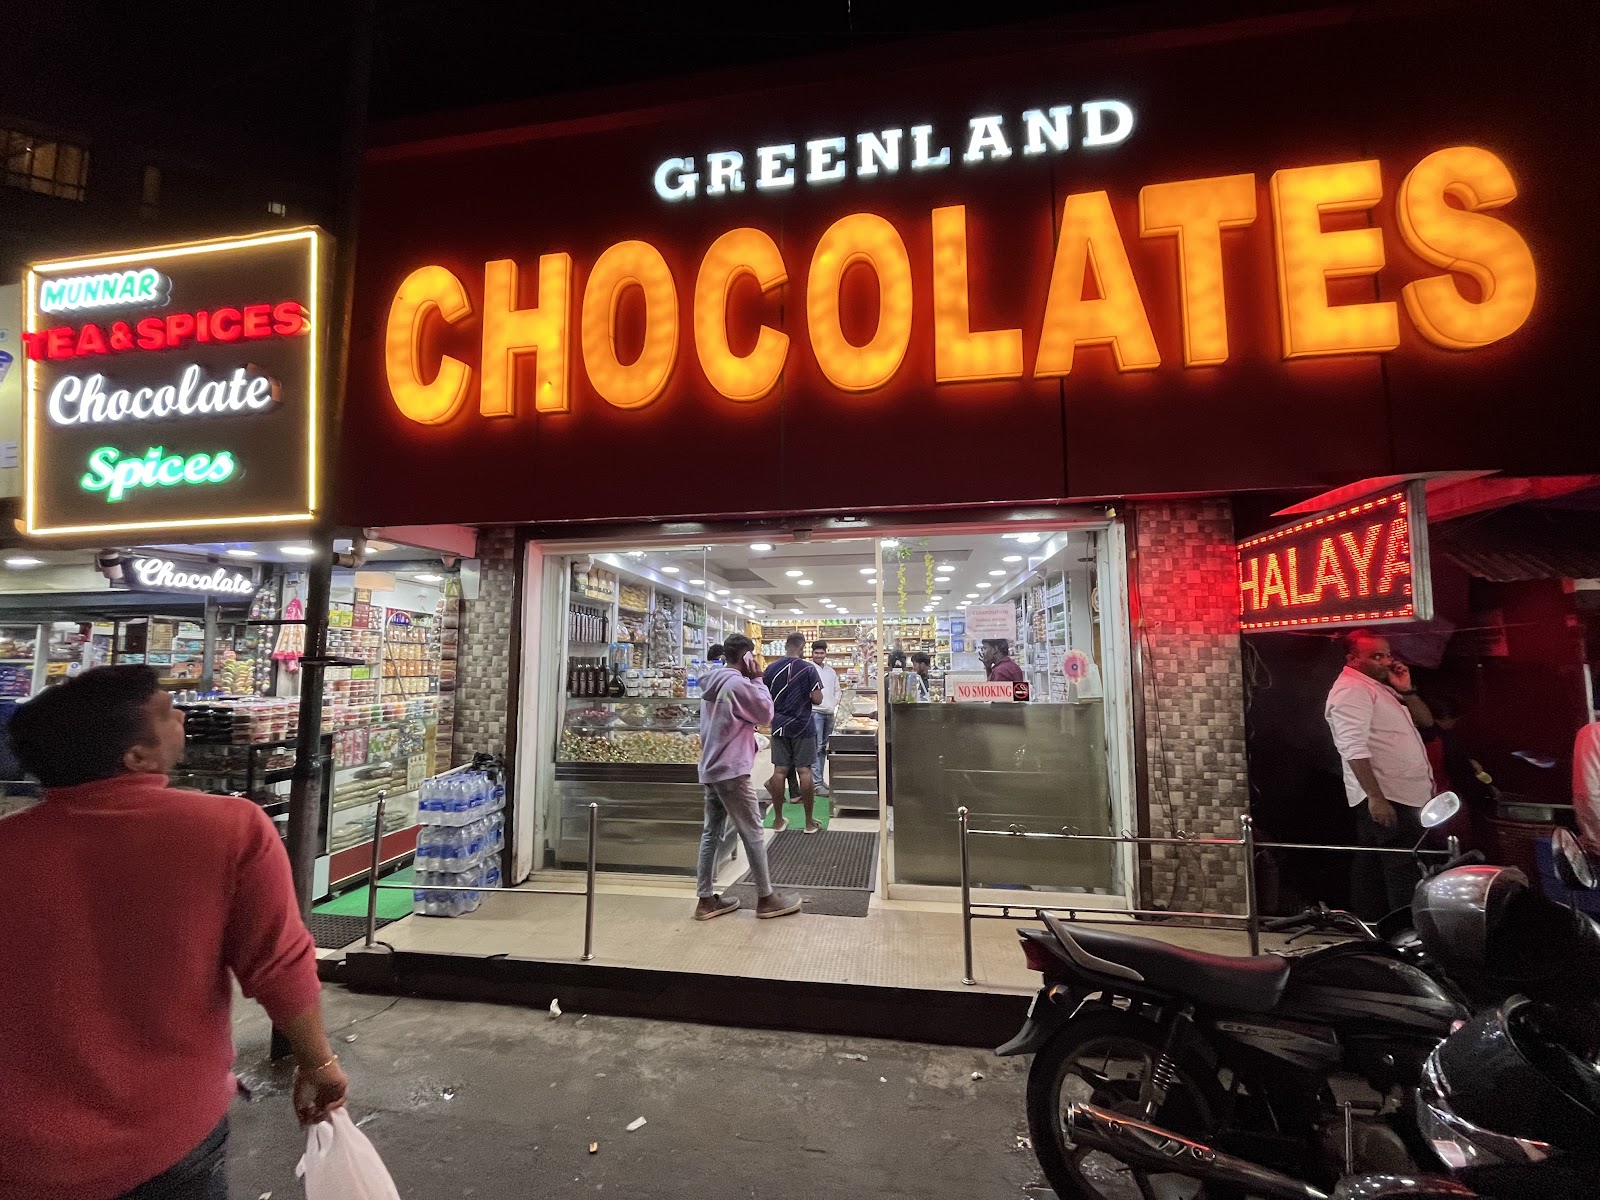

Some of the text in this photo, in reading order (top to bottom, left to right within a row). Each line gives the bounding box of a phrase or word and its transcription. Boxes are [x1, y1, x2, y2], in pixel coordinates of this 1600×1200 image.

[654, 100, 1135, 200] GREENLAND
[41, 269, 160, 312] MUNNAR
[385, 144, 1537, 427] CHOCOLATES
[49, 364, 271, 425] Chocolate
[81, 446, 235, 502] Spices
[133, 558, 254, 594] Chocolate
[958, 685, 1012, 697] NO SMOKING
